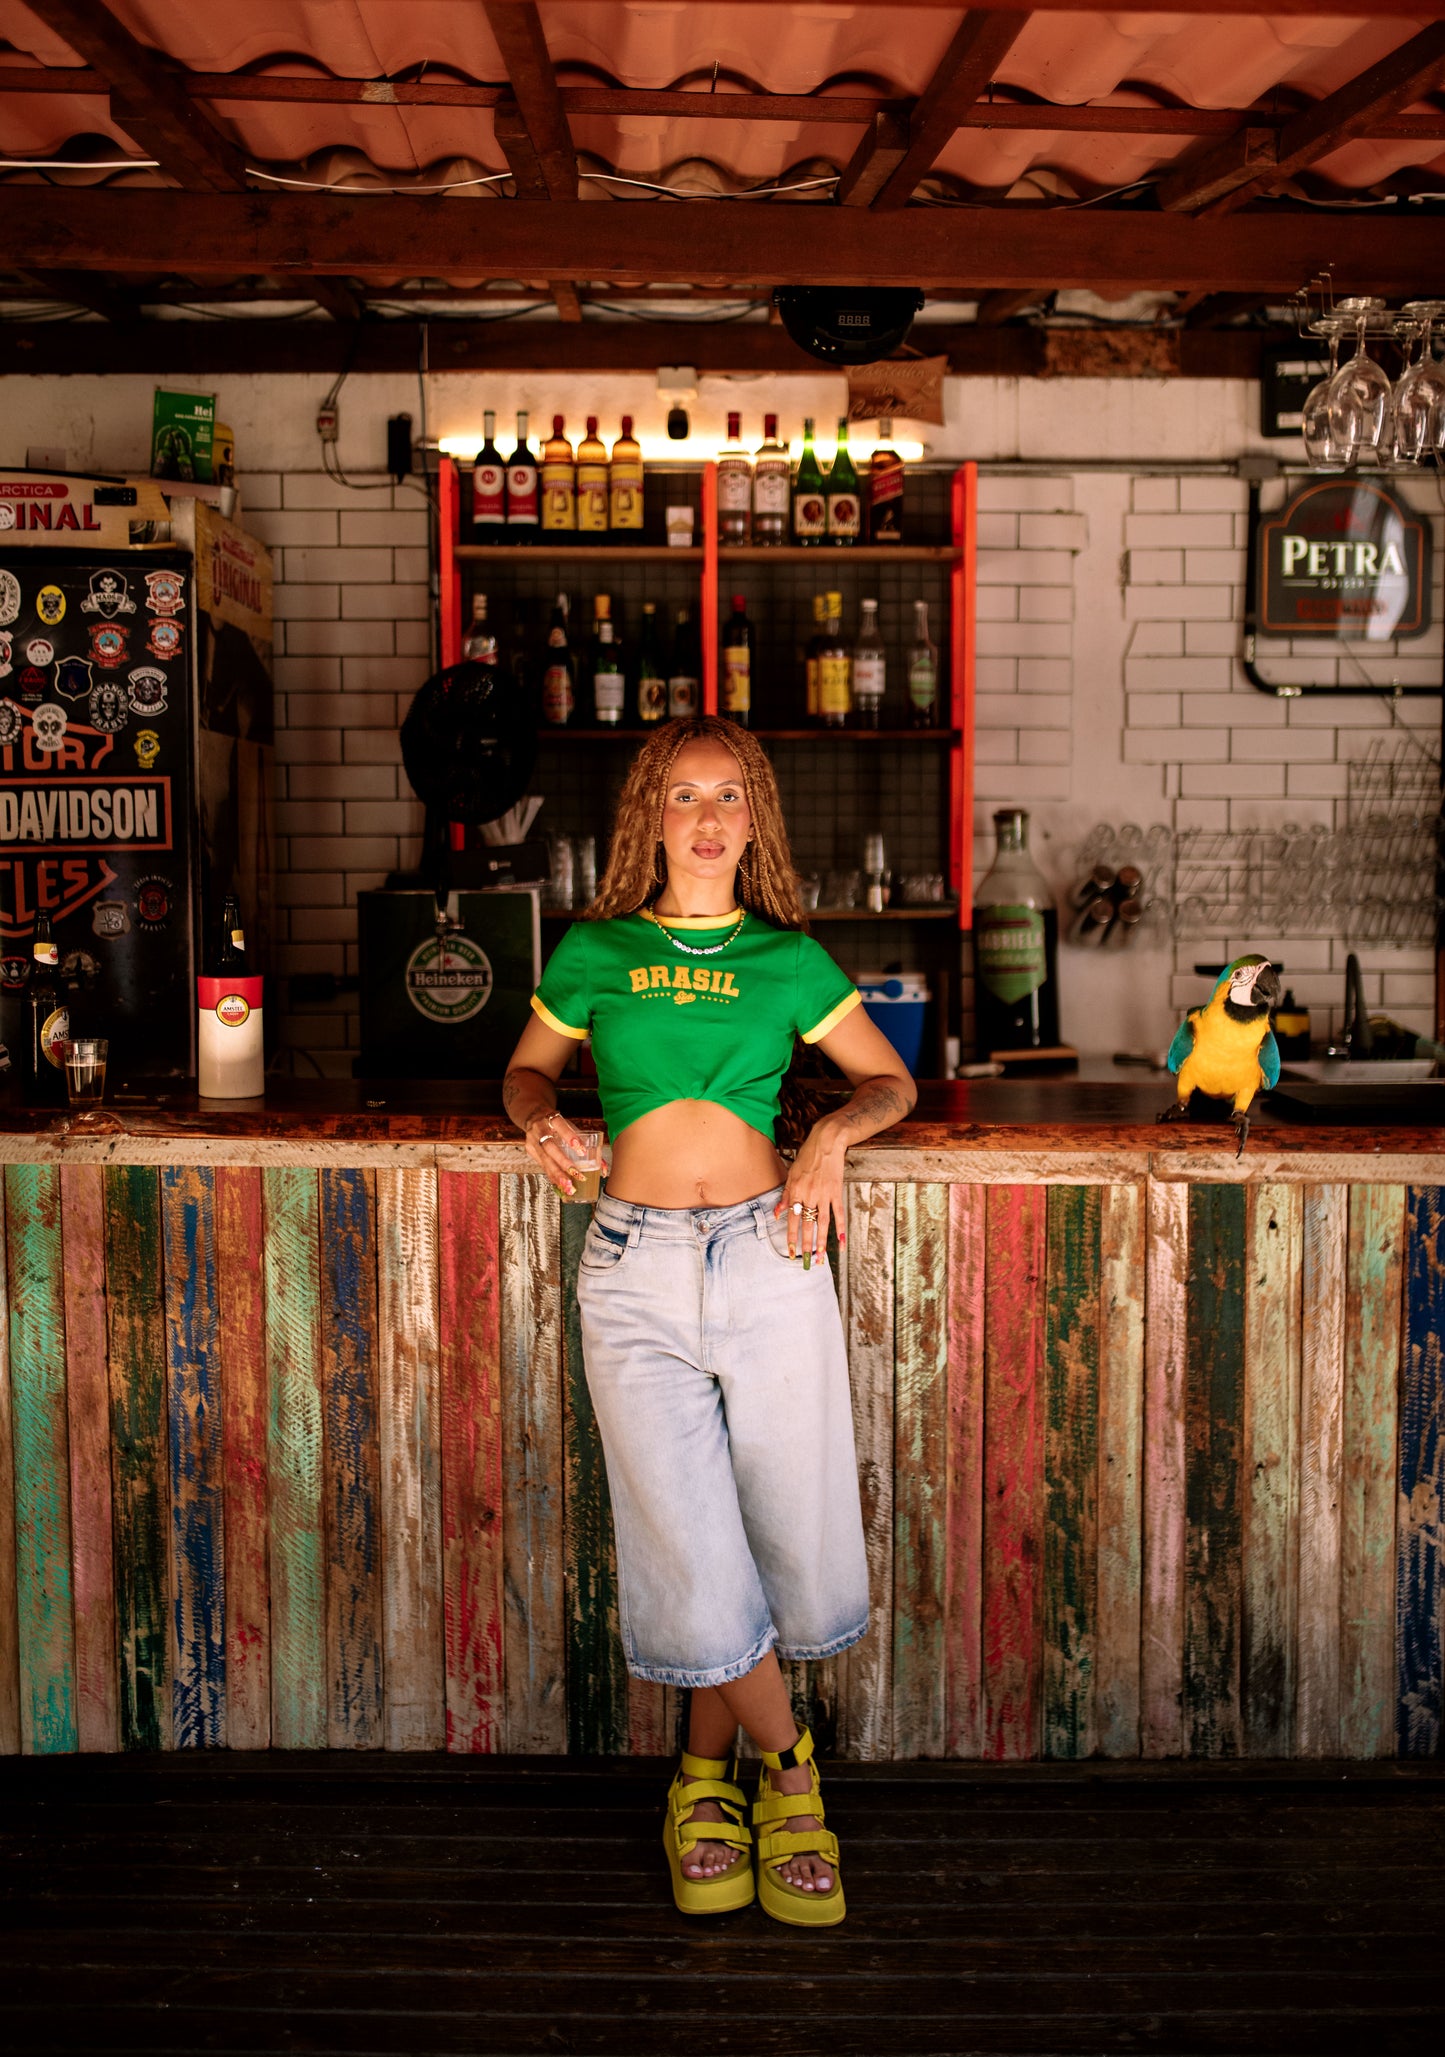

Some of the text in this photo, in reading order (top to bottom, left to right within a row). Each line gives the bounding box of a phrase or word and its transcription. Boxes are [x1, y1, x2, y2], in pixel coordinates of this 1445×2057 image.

[16, 502, 101, 531] INAL
[1281, 535, 1404, 577] PETRA
[93, 711, 127, 729] BRASIL
[0, 789, 158, 841] DAVIDSON
[415, 972, 483, 986] Heineken
[629, 965, 740, 998] BRASIL
